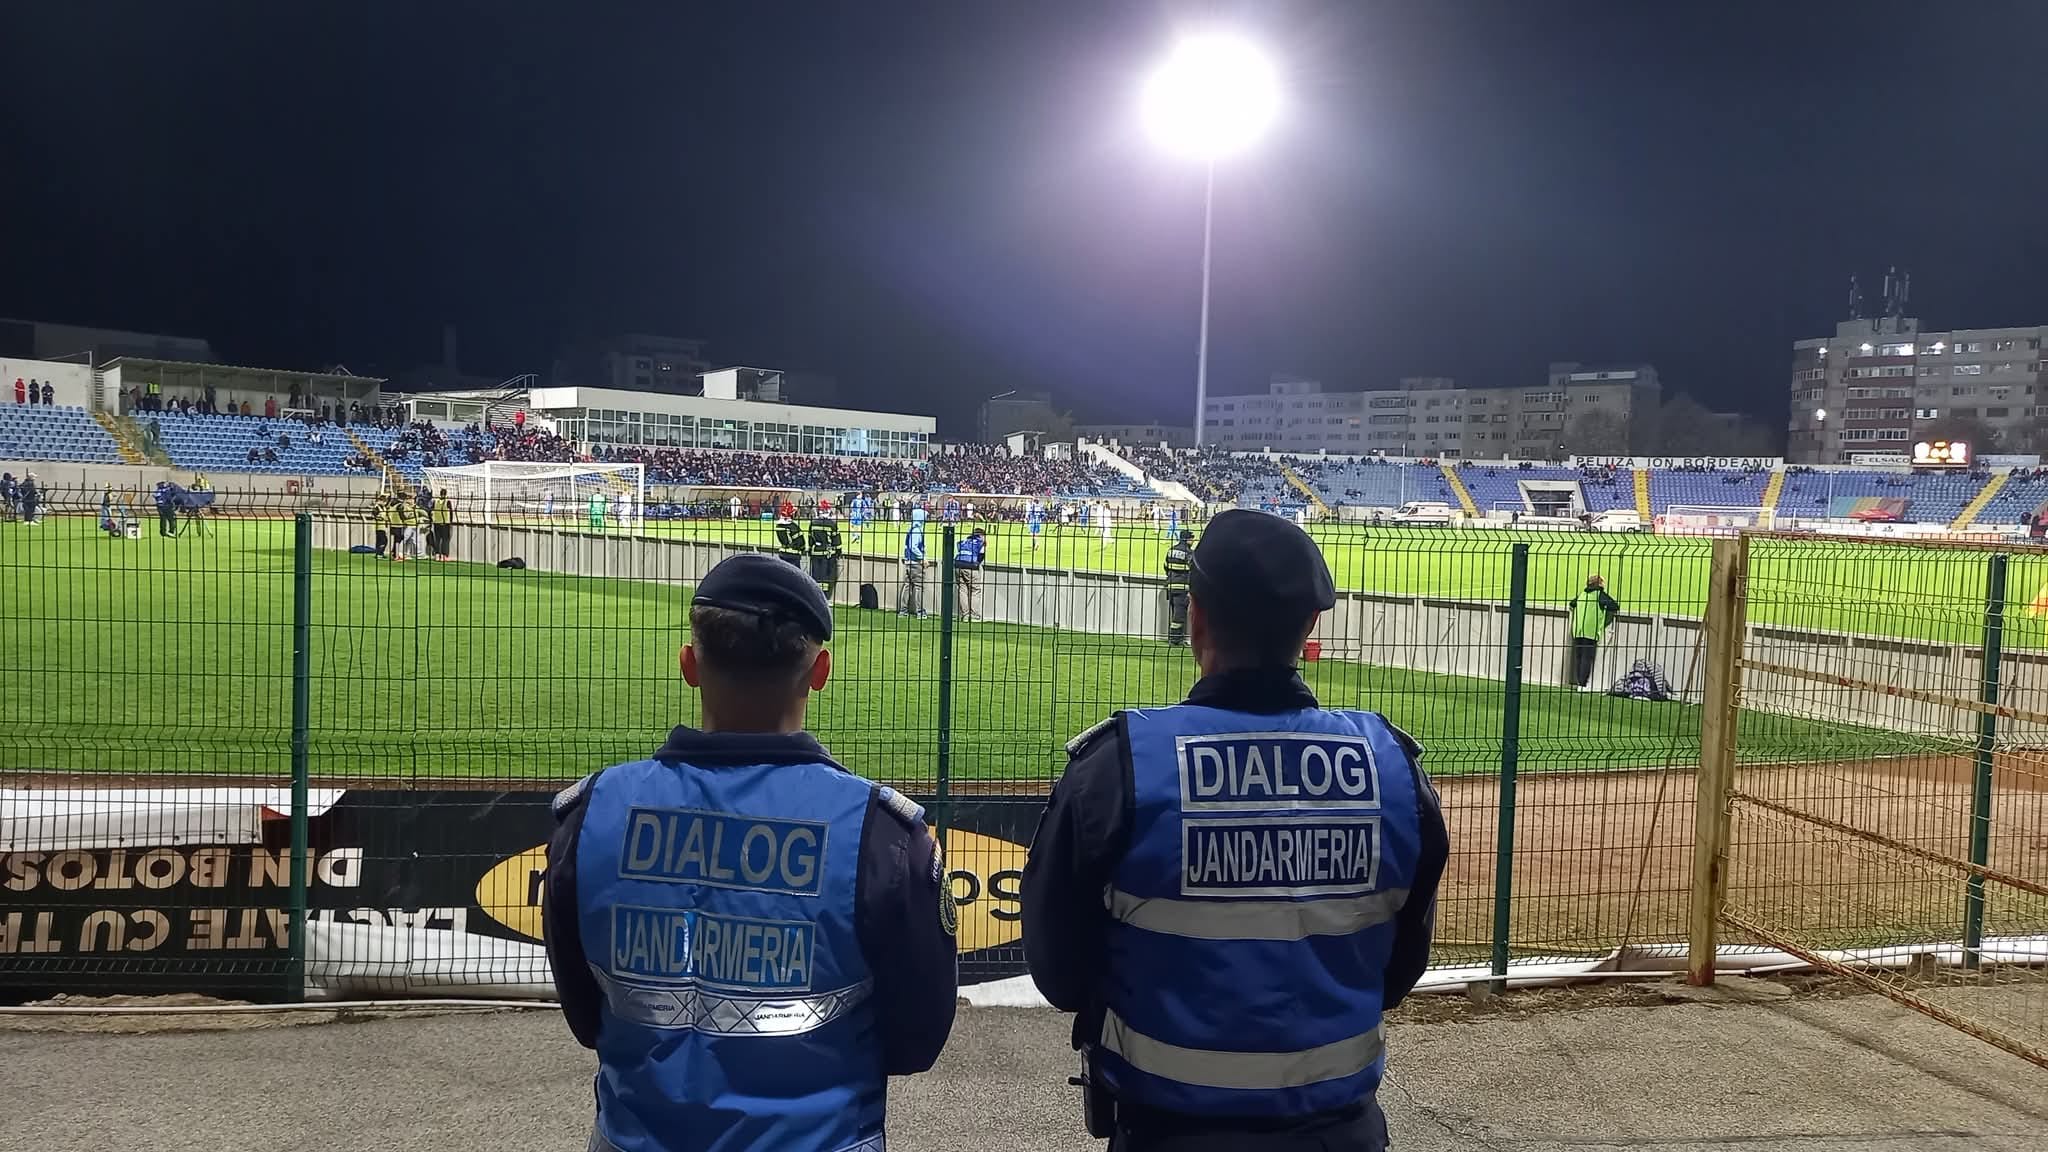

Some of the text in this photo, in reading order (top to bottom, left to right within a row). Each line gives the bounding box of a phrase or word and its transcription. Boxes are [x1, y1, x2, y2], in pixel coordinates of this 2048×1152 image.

[1576, 456, 1774, 469] PELUZA ION BORDEANU
[1868, 457, 1910, 465] ELSACO
[1192, 744, 1368, 797] DIALOG
[0, 847, 364, 891] DIN BOTOS
[627, 813, 817, 888] DIALOG
[1189, 829, 1369, 883] JANDARMERIA
[79, 910, 171, 952] CU
[616, 911, 807, 983] JANDARMERIA
